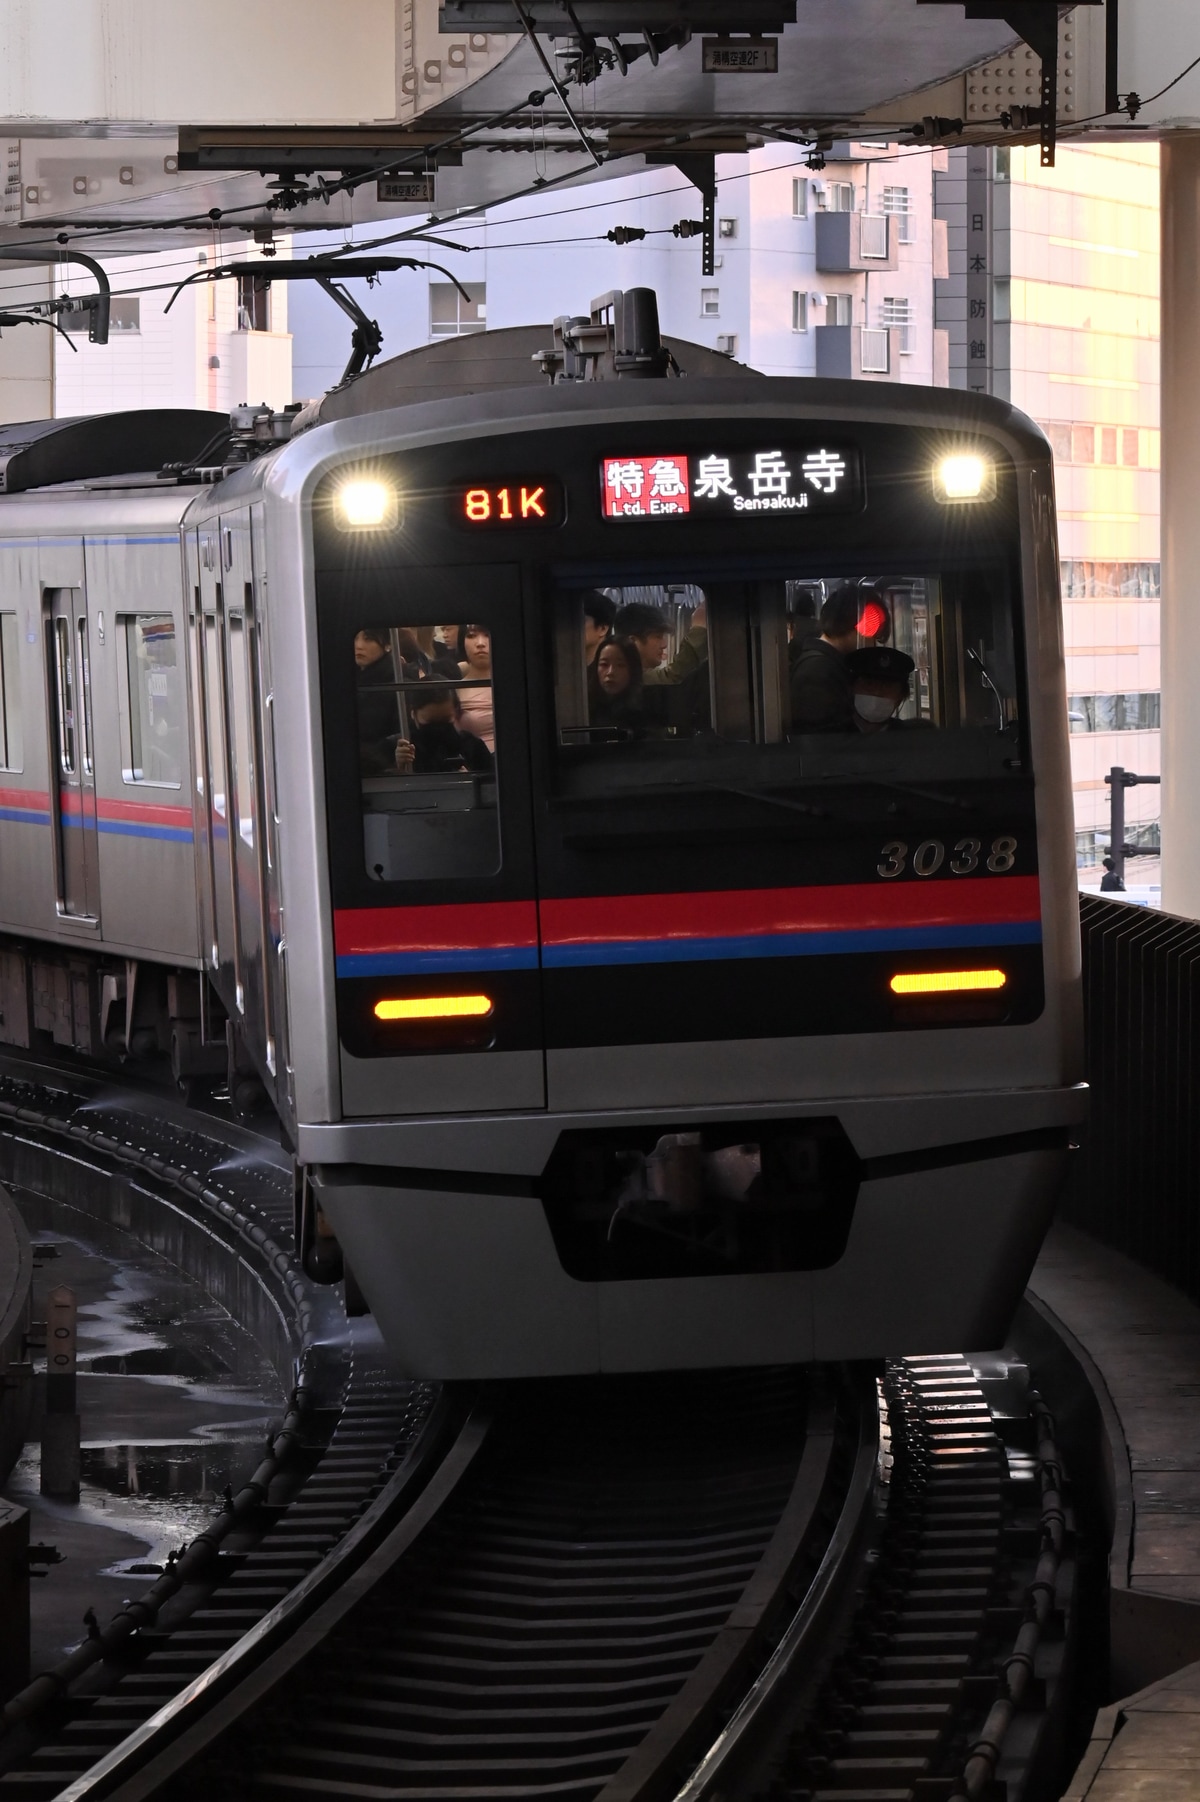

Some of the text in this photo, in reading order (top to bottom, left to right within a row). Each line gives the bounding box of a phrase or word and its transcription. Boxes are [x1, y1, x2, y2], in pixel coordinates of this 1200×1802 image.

[422, 184, 428, 197] 2
[606, 449, 846, 498] 特急 泉岳寺
[465, 487, 545, 520] 81K
[612, 500, 684, 517] Ltd. Exp.
[733, 495, 808, 511] Sengakuji
[876, 836, 1018, 877] 3038
